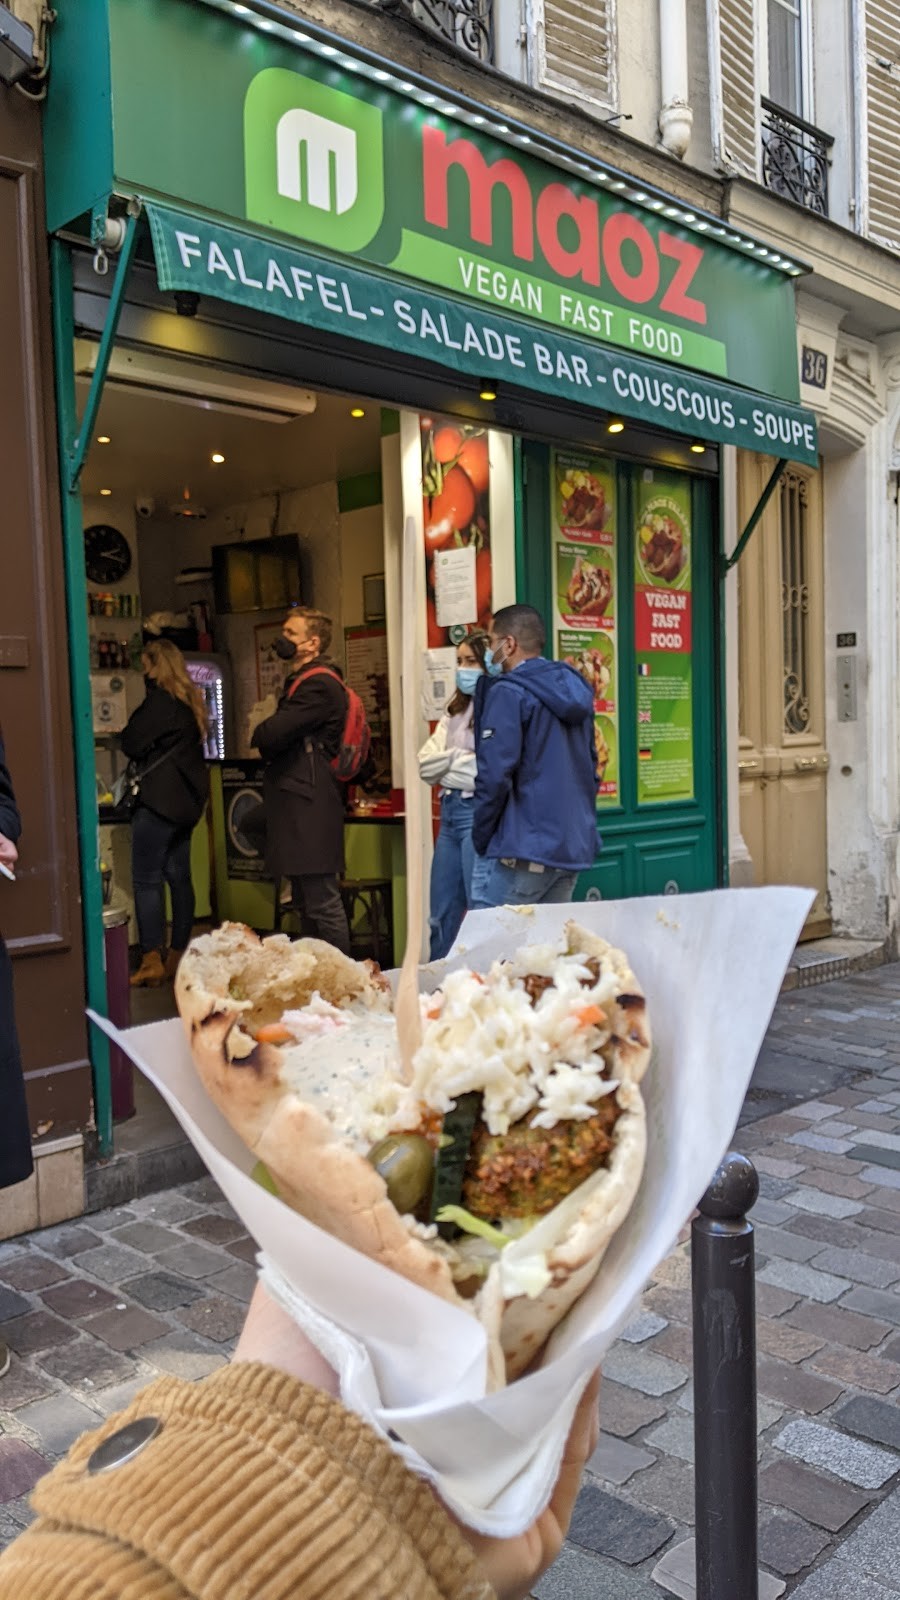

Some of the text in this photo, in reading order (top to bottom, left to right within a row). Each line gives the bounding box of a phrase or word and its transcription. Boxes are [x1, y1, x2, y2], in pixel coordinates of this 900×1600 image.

[422, 123, 707, 325] maoz
[458, 256, 683, 358] VEGAN FAST FOOD
[394, 299, 526, 368] SALADE
[533, 342, 592, 387] BAR
[753, 409, 815, 451] SOUPE
[804, 350, 825, 384] 36
[645, 592, 687, 610] VEGAN
[652, 612, 681, 629] FAST
[650, 632, 683, 649] FOOD
